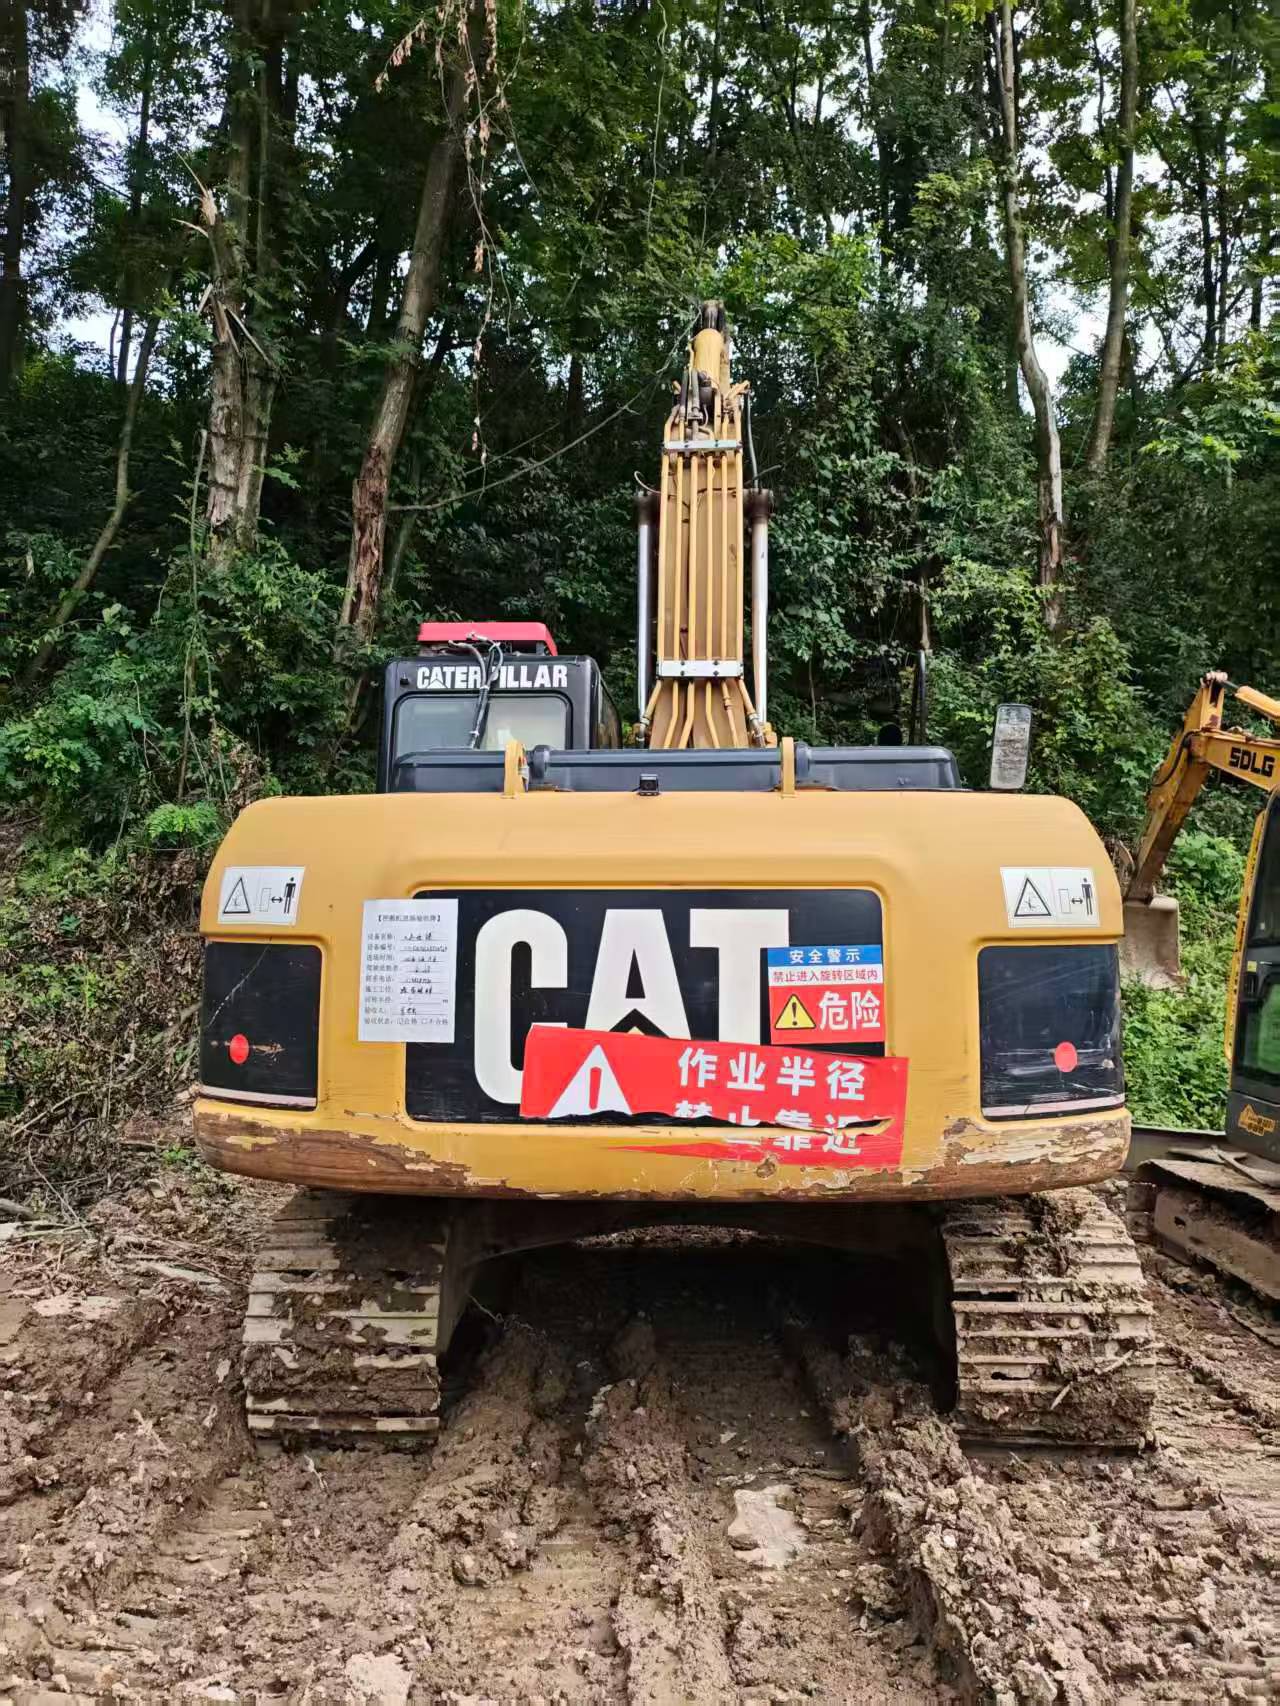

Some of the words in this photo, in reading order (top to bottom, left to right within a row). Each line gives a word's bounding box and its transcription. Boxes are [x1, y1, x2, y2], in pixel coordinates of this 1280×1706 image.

[1229, 746, 1275, 778] SDLG
[789, 948, 860, 964] 安全警示
[772, 968, 878, 982] 禁止进入旋转区域内
[474, 908, 790, 1105] CAT
[818, 989, 880, 1031] 危险
[678, 1047, 865, 1101] 作业半径
